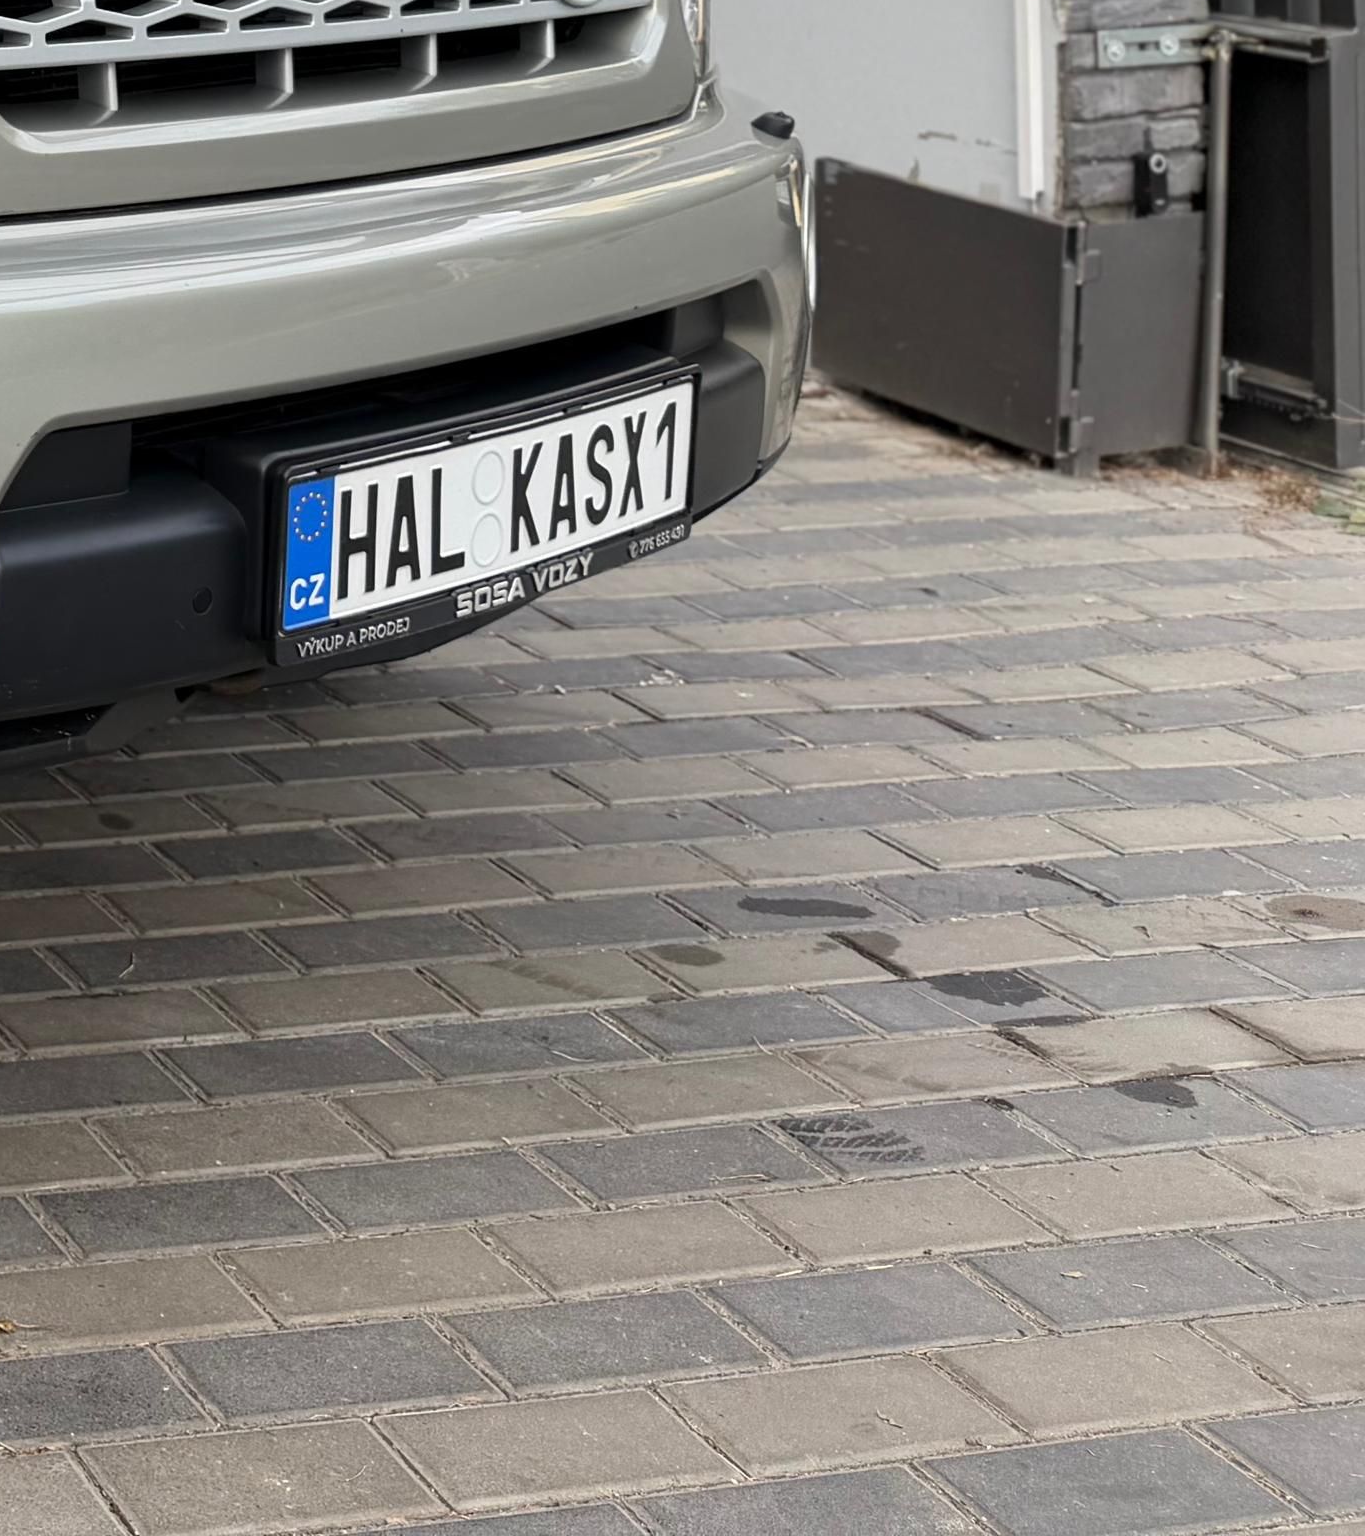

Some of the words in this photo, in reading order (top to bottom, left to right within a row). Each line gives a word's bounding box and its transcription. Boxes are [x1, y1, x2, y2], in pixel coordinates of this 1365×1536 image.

[337, 467, 465, 601] HAL
[510, 402, 677, 554] KASX1
[289, 573, 325, 611] CZ
[456, 577, 525, 618] SOSA
[532, 552, 594, 593] VOZY
[296, 634, 344, 658] VÝKUP
[346, 632, 357, 646] A
[359, 617, 410, 643] PRODEJ
